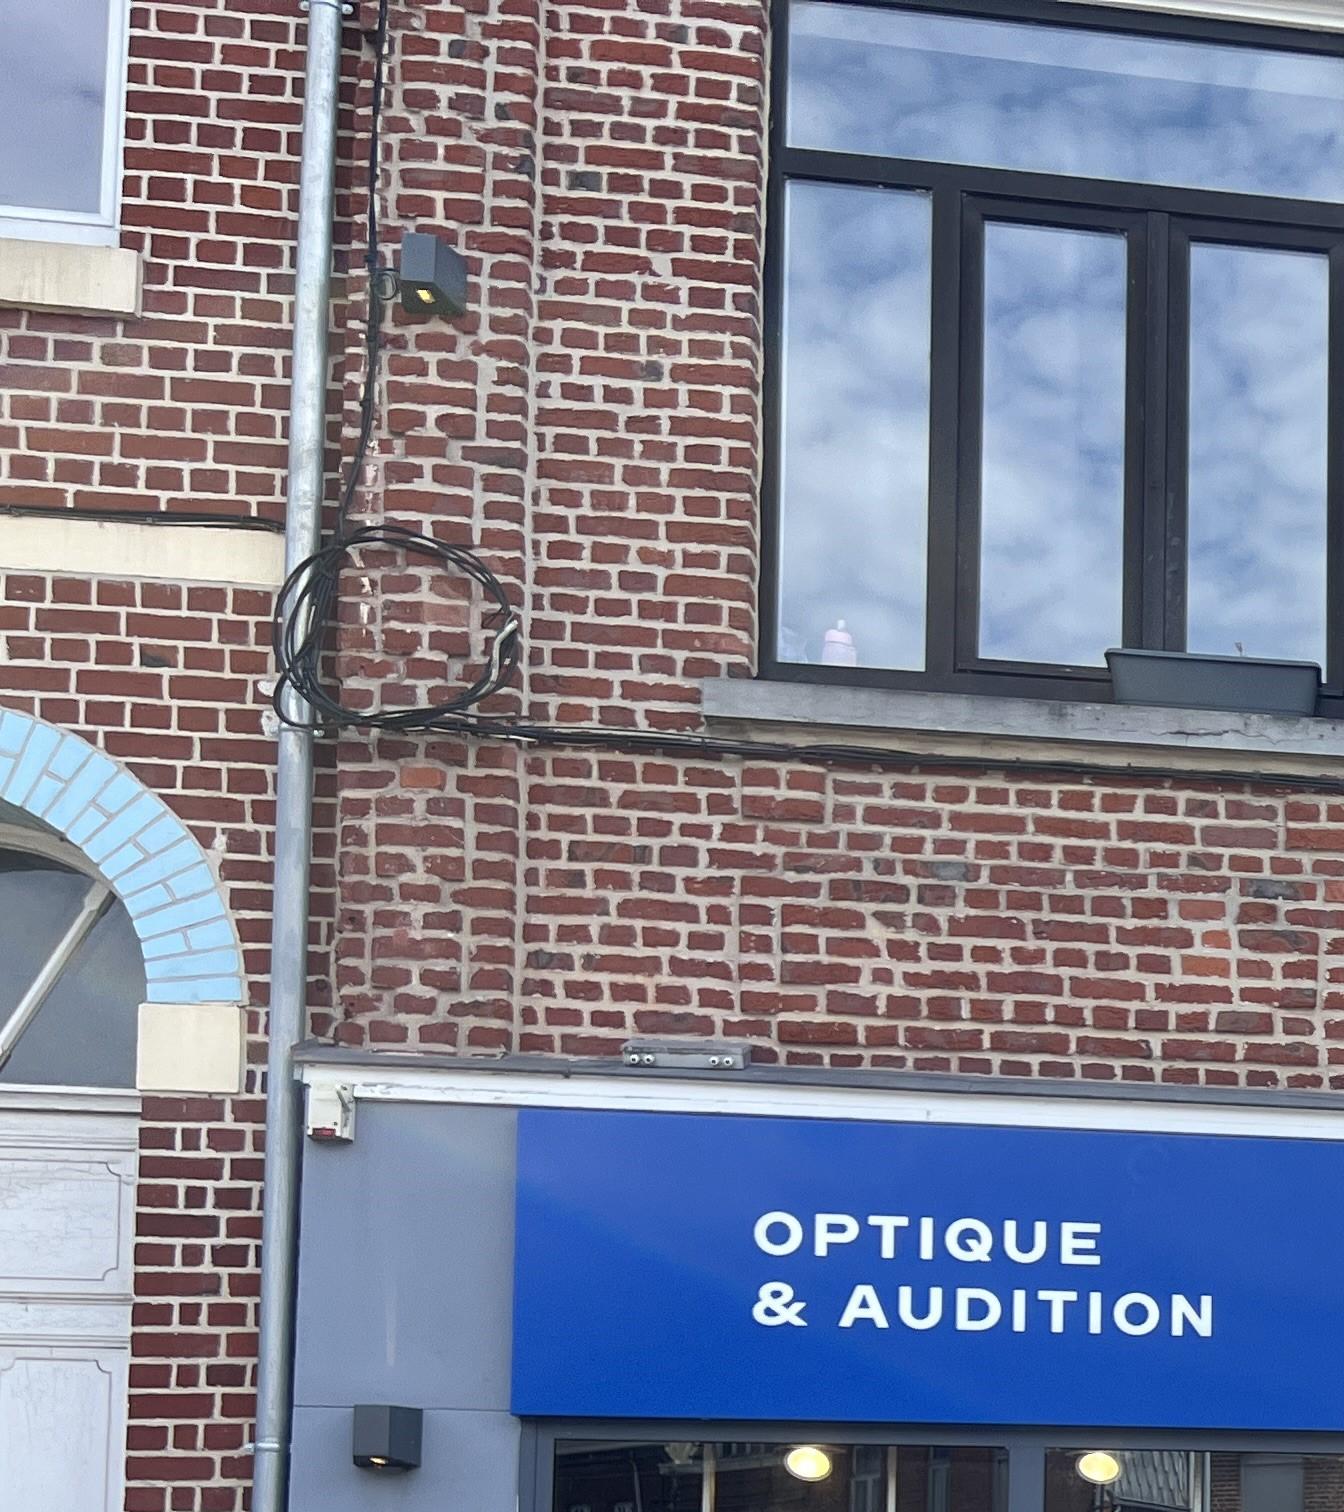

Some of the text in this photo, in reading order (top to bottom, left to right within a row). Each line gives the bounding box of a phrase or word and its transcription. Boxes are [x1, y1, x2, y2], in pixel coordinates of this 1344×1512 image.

[752, 1210, 1103, 1267] OPTIQUE
[751, 1280, 1215, 1338] & AUDITION
